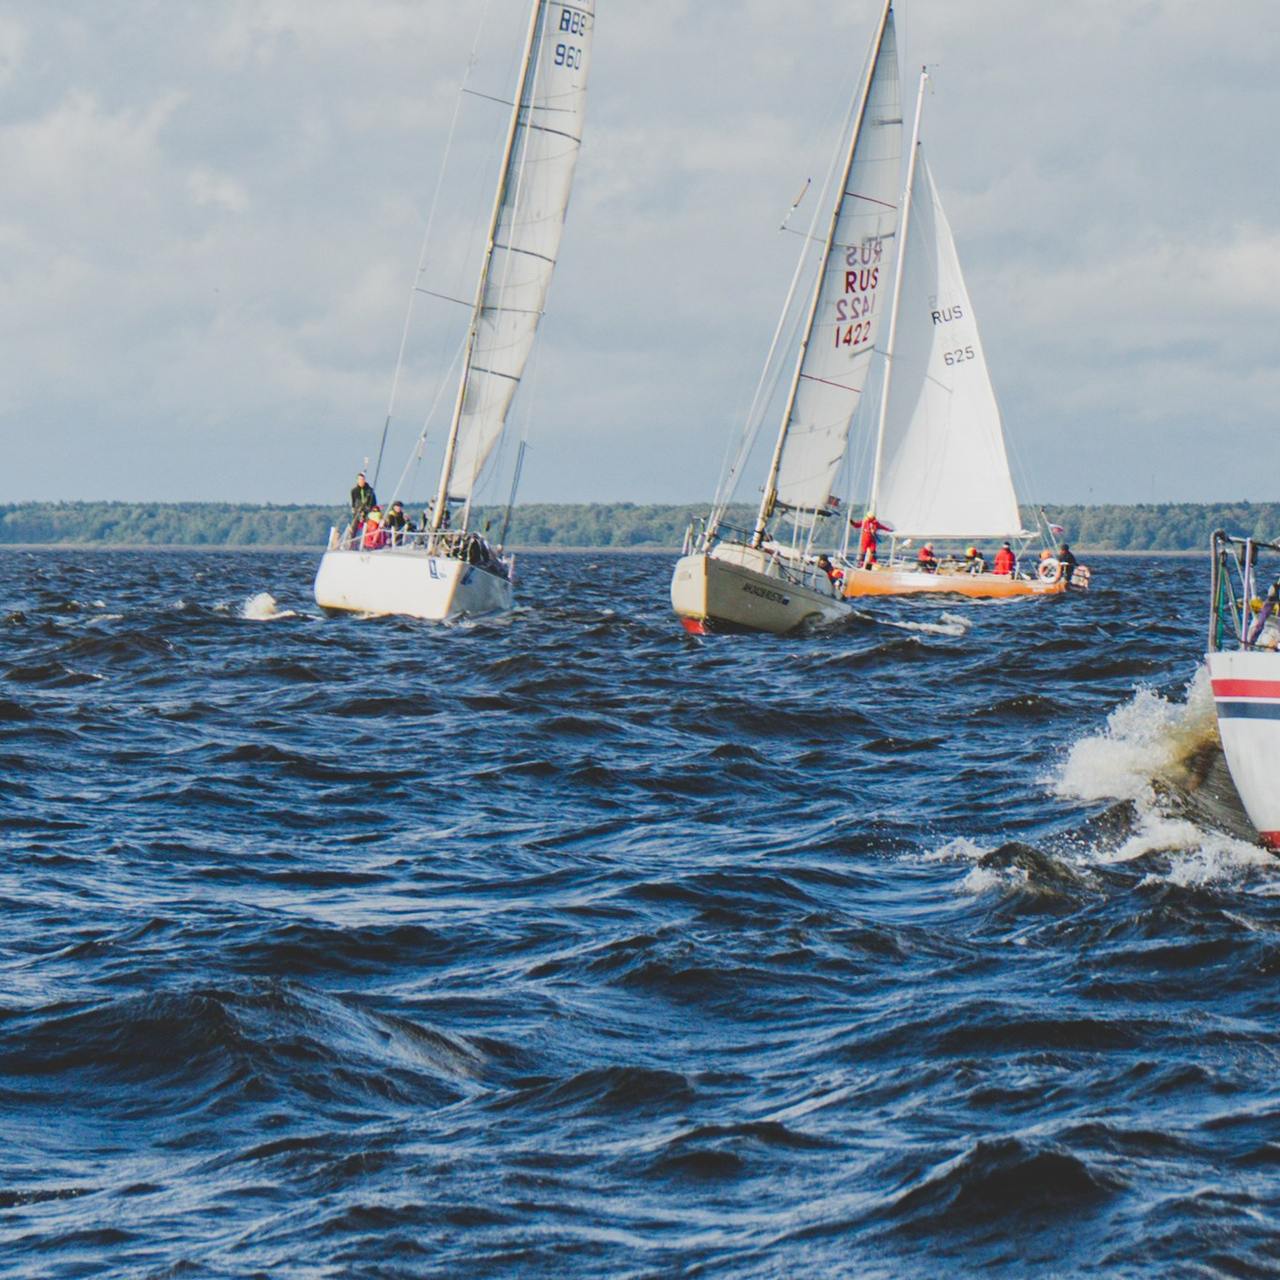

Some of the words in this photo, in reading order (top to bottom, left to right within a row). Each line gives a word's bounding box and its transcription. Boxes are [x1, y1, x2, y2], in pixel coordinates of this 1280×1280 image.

[554, 43, 582, 70] 960
[844, 266, 880, 294] RUS
[930, 304, 964, 326] RUS
[834, 320, 872, 349] 1422
[943, 345, 975, 366] 625
